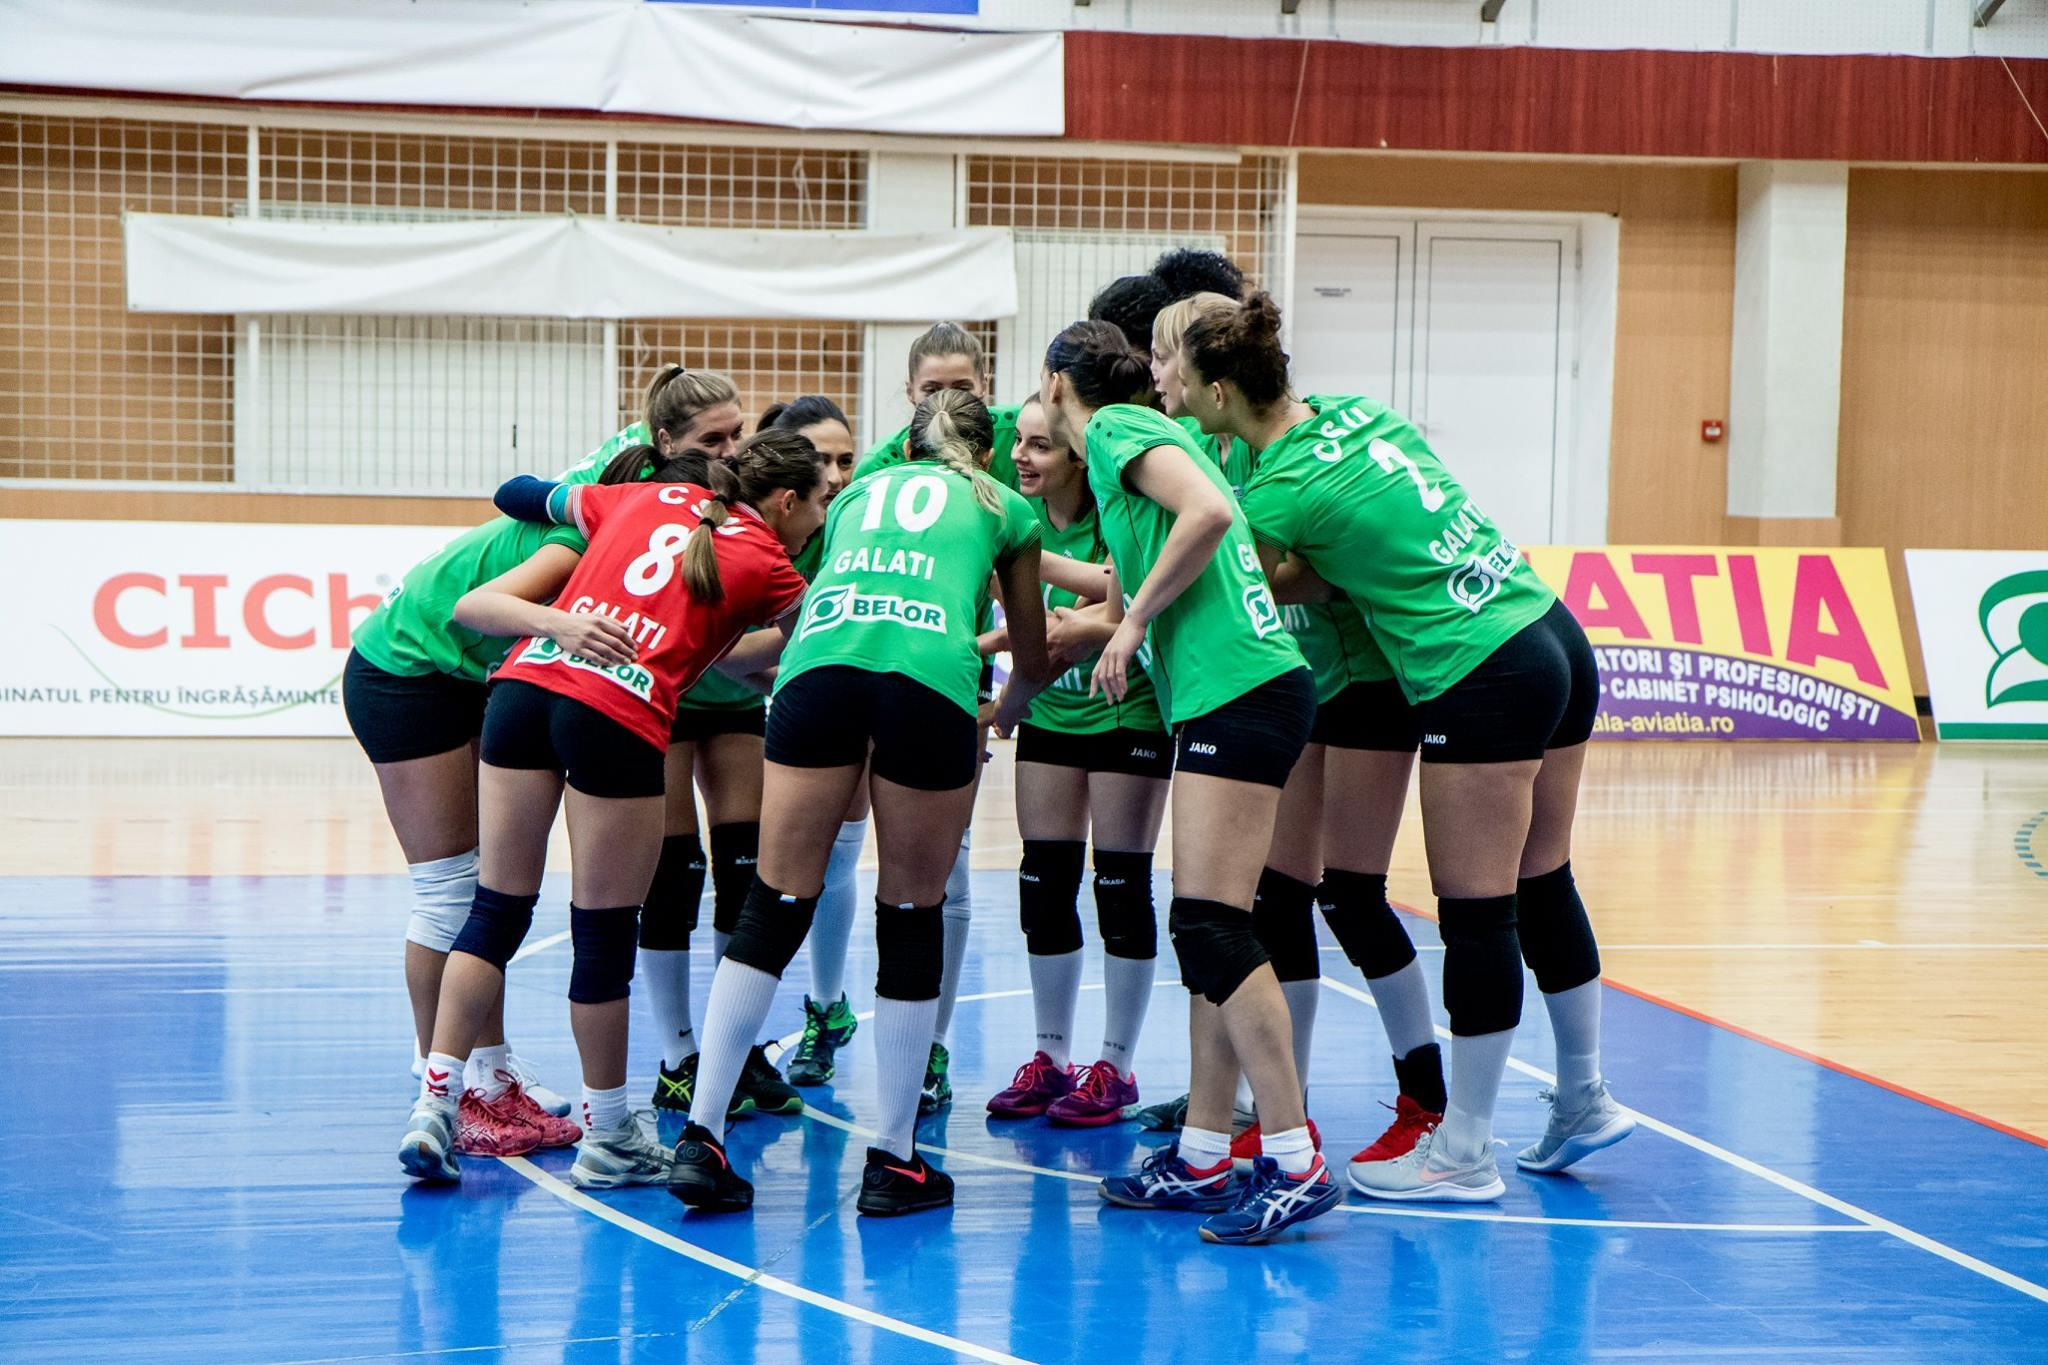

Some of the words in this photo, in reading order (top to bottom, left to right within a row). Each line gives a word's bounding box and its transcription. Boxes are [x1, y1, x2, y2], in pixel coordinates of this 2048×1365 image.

[1312, 407, 1374, 463] CSU
[860, 475, 948, 533] 10
[623, 523, 692, 597] 8
[833, 547, 936, 581] GALATI
[852, 598, 943, 627] BELOR
[1520, 551, 1890, 691] ATIA
[0, 686, 83, 704] INATUL
[89, 687, 171, 704] PENTRU
[1609, 676, 1700, 704] CABINET
[1704, 684, 1831, 732] PSIHOLOGIC
[1130, 746, 1158, 760] JAKO
[1188, 741, 1218, 756] JAKO
[1424, 733, 1448, 745] JAKO
